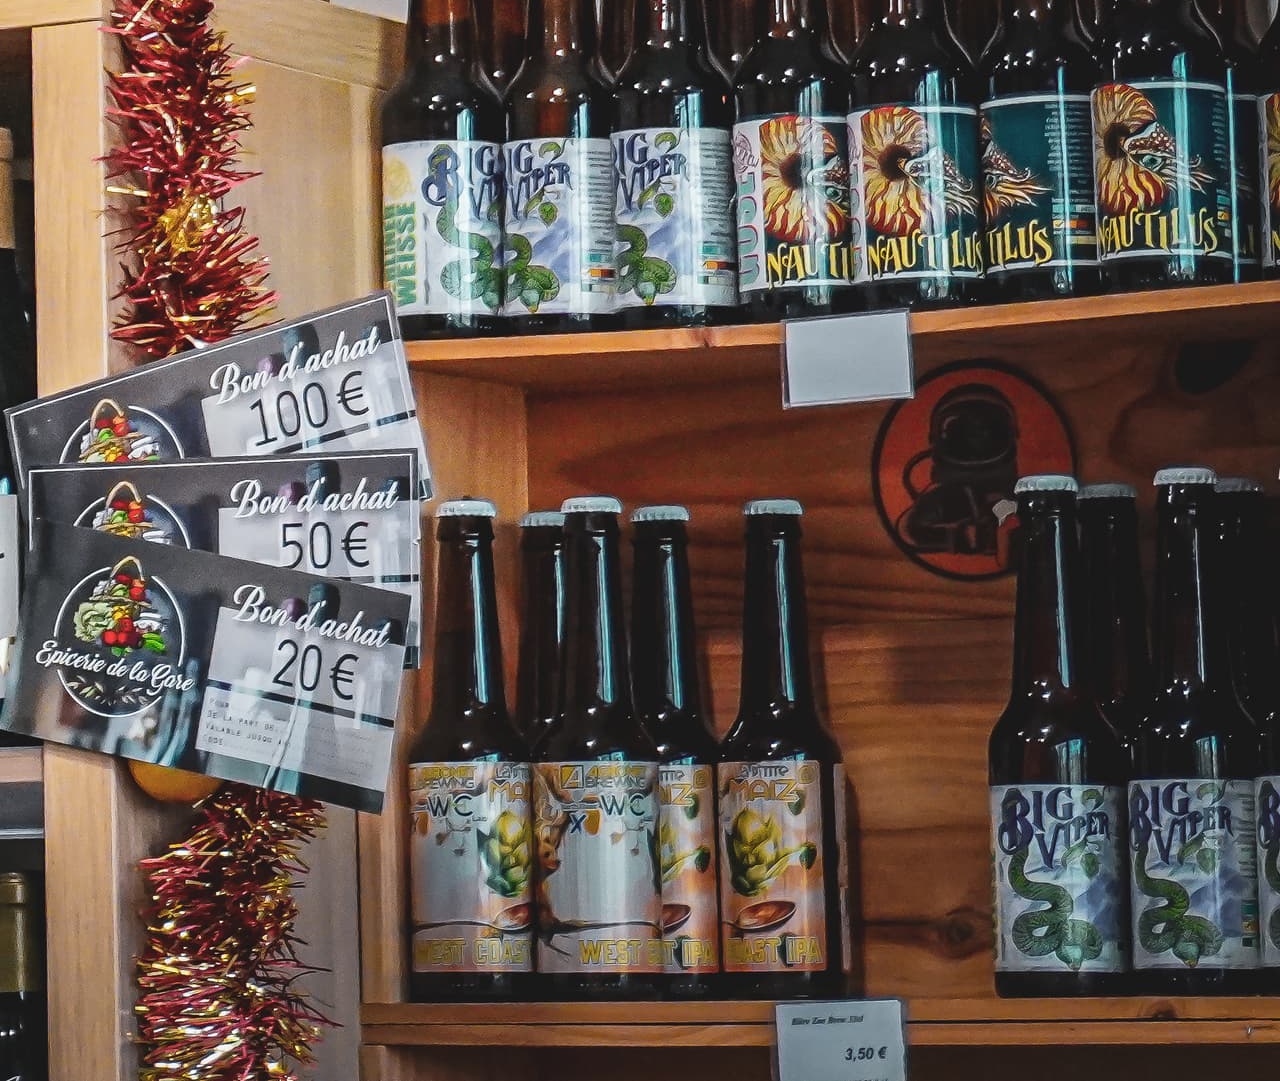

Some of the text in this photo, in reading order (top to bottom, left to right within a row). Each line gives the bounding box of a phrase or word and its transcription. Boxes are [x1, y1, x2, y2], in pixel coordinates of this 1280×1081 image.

[395, 202, 417, 307] WEISSE
[868, 228, 986, 282] NAUTILUS
[1099, 207, 1218, 258] NAUTILUS
[209, 326, 382, 406] Bon d'achat
[249, 370, 370, 447] 100 €
[230, 476, 400, 519] Bon d'achat
[280, 521, 370, 570] 50 €
[233, 584, 393, 650] Bon d'achat
[35, 640, 195, 696] Epicerie de la Gare
[272, 638, 360, 702] 20 €
[998, 787, 1074, 856] BIG
[1151, 804, 1235, 866] VIPER
[579, 939, 642, 965] WEST
[786, 935, 824, 965] IPA
[844, 1046, 888, 1062] 3,50 €
